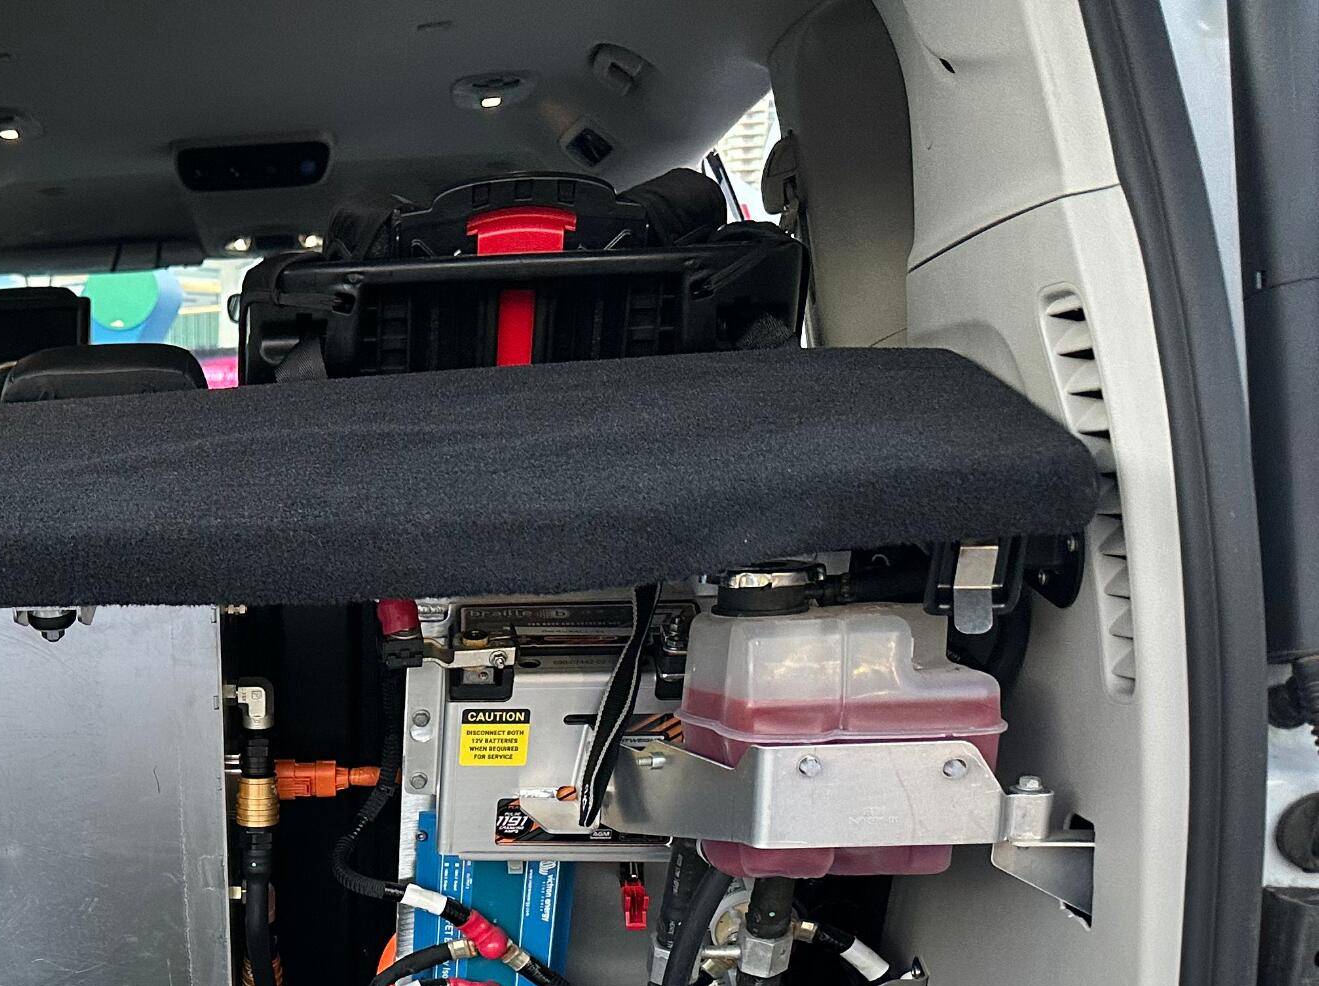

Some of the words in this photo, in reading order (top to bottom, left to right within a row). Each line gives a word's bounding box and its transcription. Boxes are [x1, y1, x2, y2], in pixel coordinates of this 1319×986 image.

[468, 712, 525, 722] CAUTION
[496, 816, 529, 827] 1191
[544, 874, 555, 898] victron
[540, 898, 552, 922] energy
